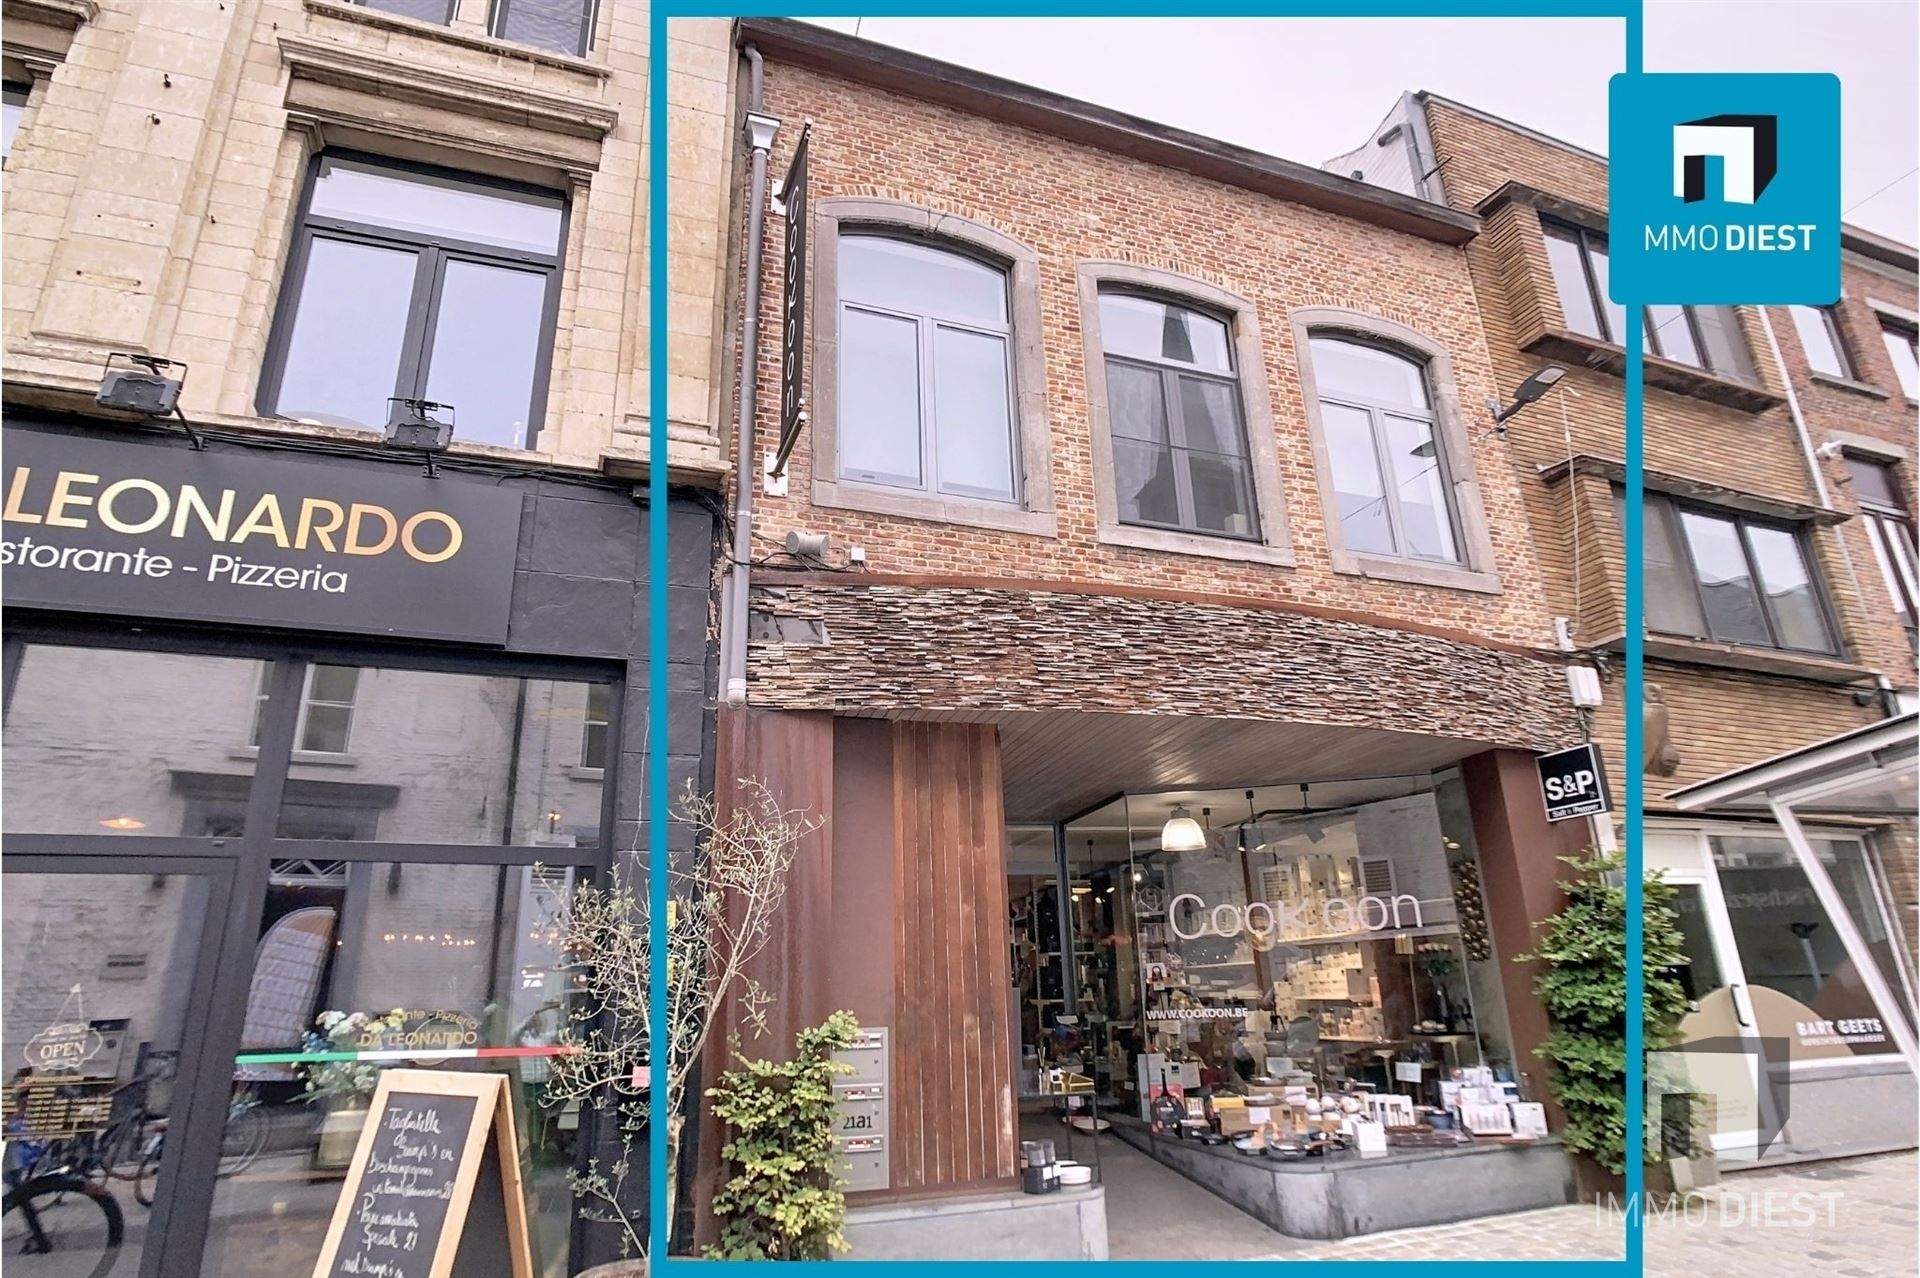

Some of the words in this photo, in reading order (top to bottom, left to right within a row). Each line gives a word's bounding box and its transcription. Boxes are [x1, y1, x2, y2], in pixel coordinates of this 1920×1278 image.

[2, 466, 464, 564] LEONARDO
[2, 536, 173, 578] storante
[206, 554, 349, 594] Pizzeria
[1544, 769, 1594, 801] S&P
[1146, 1006, 1249, 1021] WWW.COOKOON.BE
[1795, 1020, 1835, 1037] BART
[1836, 1017, 1883, 1034] GEETS
[388, 1030, 478, 1047] LEONARDO
[40, 1040, 87, 1060] OPEN
[842, 1115, 873, 1130] 21a1
